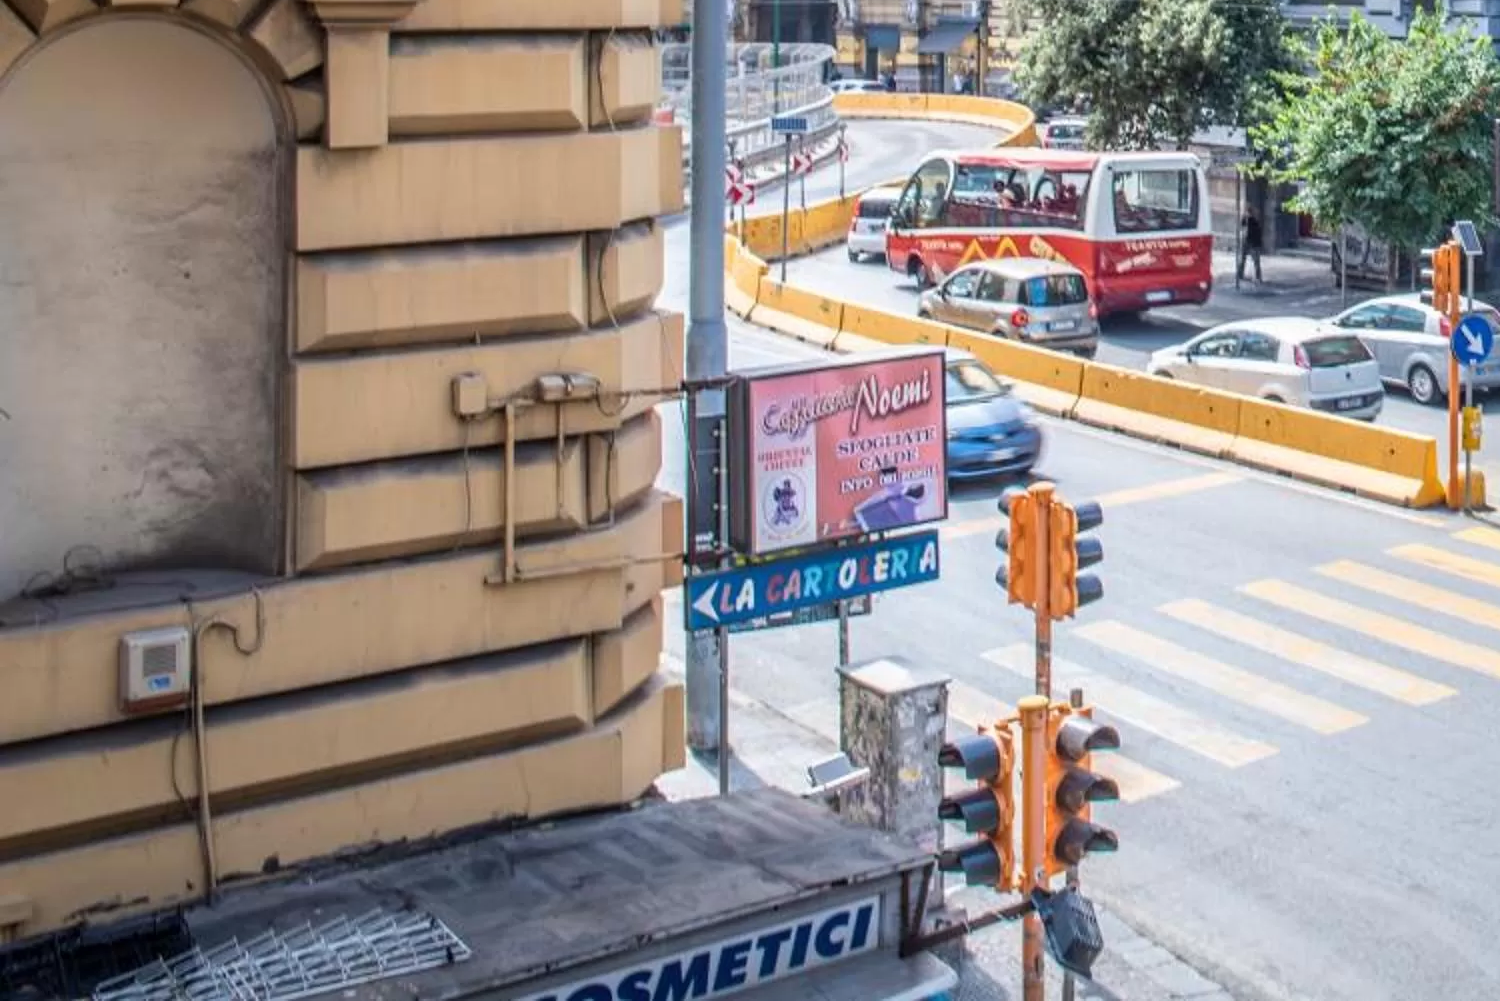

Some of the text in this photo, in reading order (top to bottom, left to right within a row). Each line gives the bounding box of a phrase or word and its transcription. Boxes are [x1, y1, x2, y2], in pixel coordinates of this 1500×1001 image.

[849, 368, 931, 435] Noemi
[837, 427, 936, 455] SFOGLIATE
[719, 541, 937, 614] LA CARTOLERIA
[533, 903, 875, 1001] SMETICI
